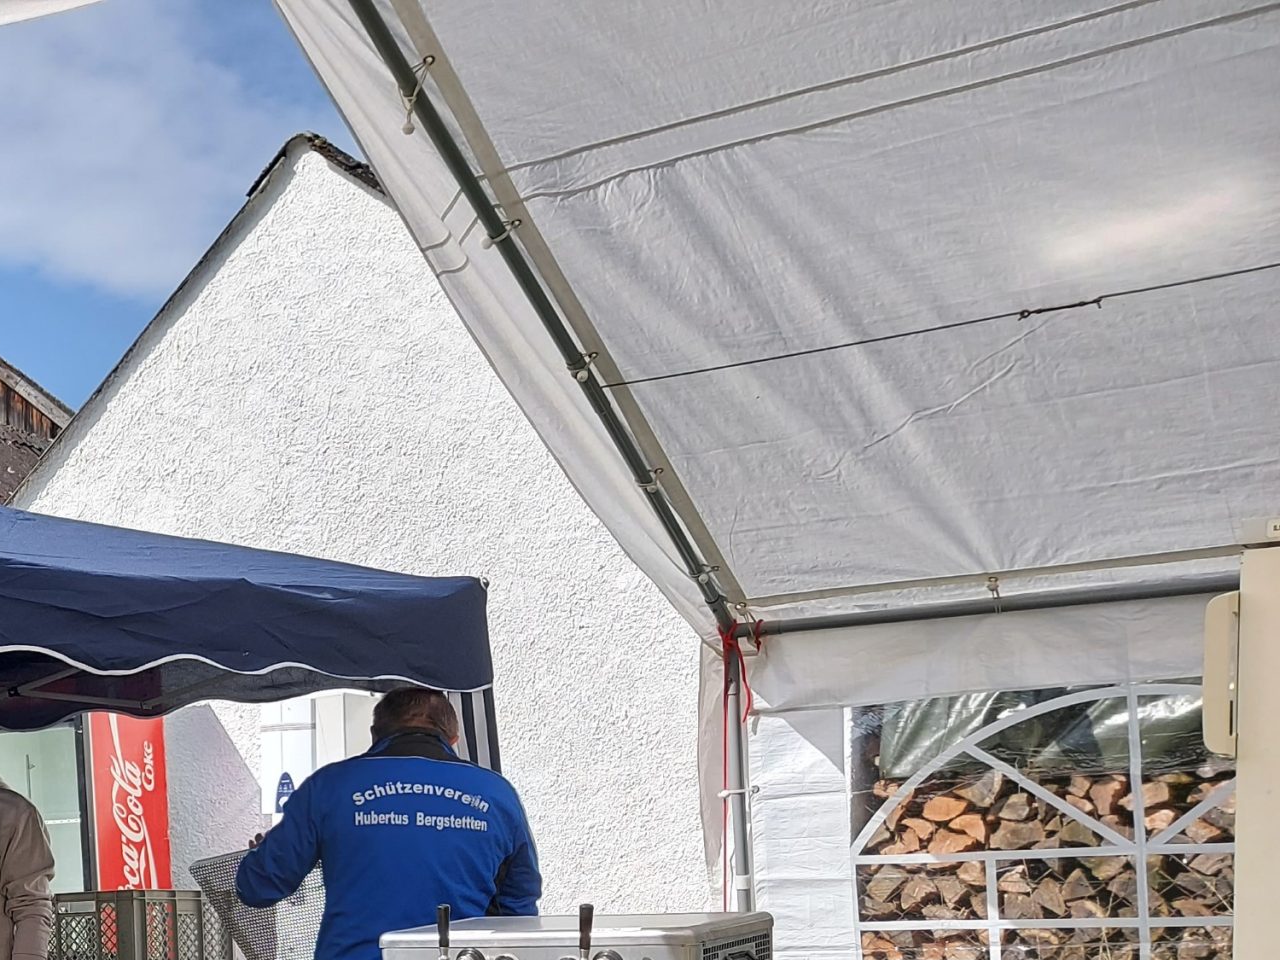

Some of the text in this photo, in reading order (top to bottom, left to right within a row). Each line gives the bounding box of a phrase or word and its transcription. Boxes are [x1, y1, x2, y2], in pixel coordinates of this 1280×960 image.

[142, 740, 155, 792] Coke
[352, 781, 490, 813] Schützenverein
[354, 810, 409, 826] Hubertus
